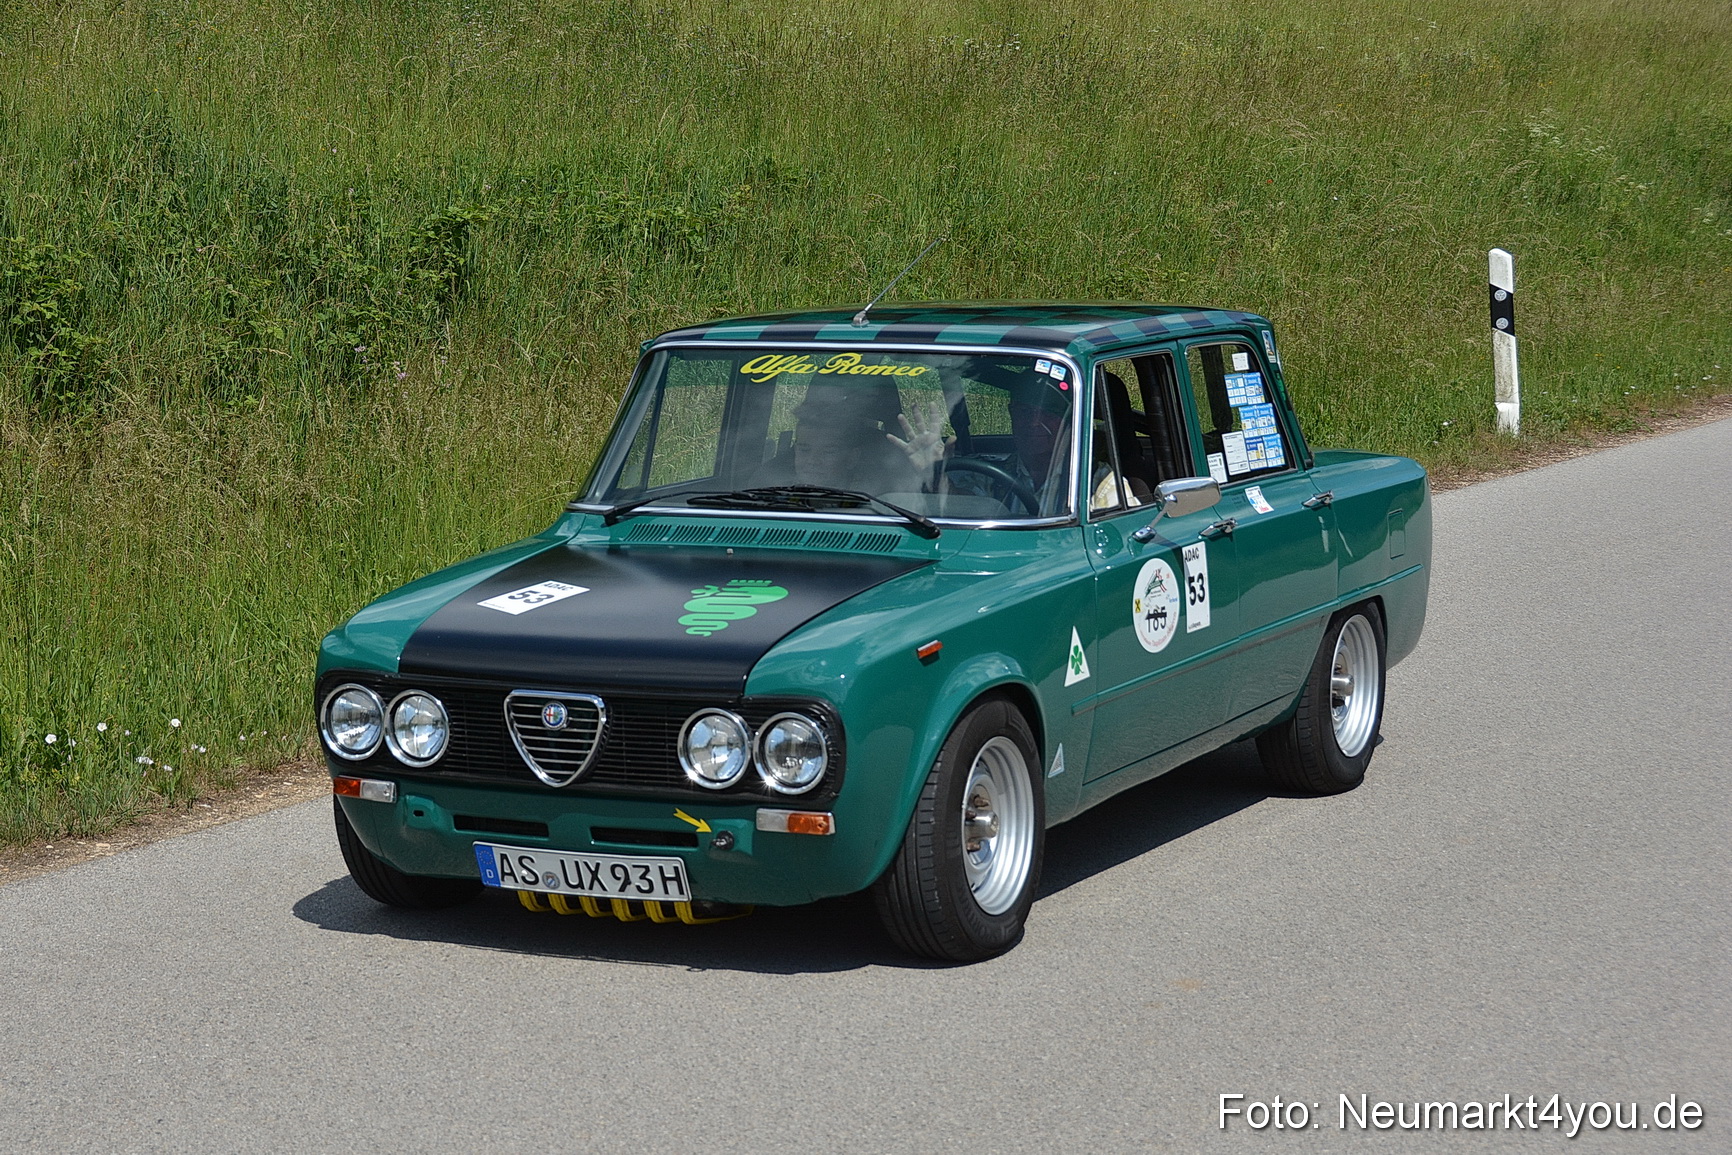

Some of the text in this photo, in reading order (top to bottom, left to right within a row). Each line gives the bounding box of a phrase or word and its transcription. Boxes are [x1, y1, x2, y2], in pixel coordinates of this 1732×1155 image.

[740, 352, 928, 383] Alfa Romeo
[1184, 547, 1200, 563] ADAC
[508, 590, 554, 604] 53
[1188, 572, 1206, 606] 53
[486, 868, 494, 879] D
[499, 853, 540, 886] AS
